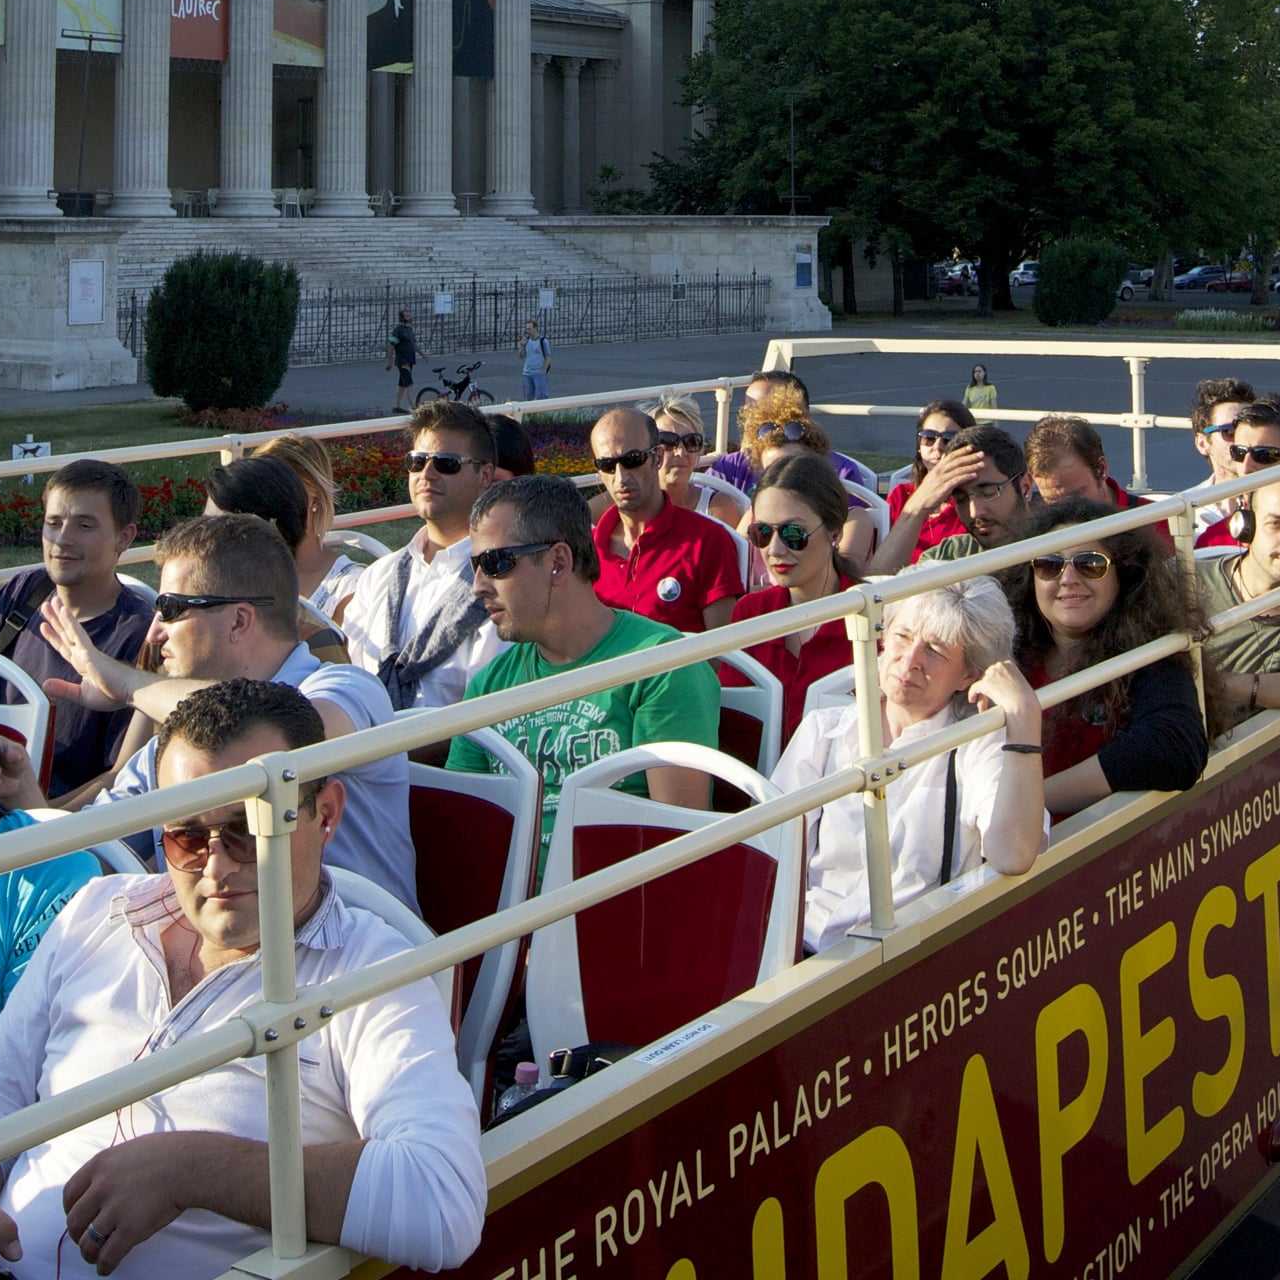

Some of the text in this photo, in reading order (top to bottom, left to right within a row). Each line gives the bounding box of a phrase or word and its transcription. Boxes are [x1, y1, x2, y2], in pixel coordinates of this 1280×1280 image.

[529, 715, 546, 728] THE
[595, 1149, 715, 1267] ROYAL
[729, 1055, 852, 1178] PALACE
[884, 971, 988, 1076] HEROES
[996, 907, 1086, 1000] SQUARE
[1105, 870, 1144, 926] THE
[1150, 838, 1195, 899] MAIN
[1160, 1166, 1195, 1229] THE
[1200, 1113, 1253, 1191] OPERA
